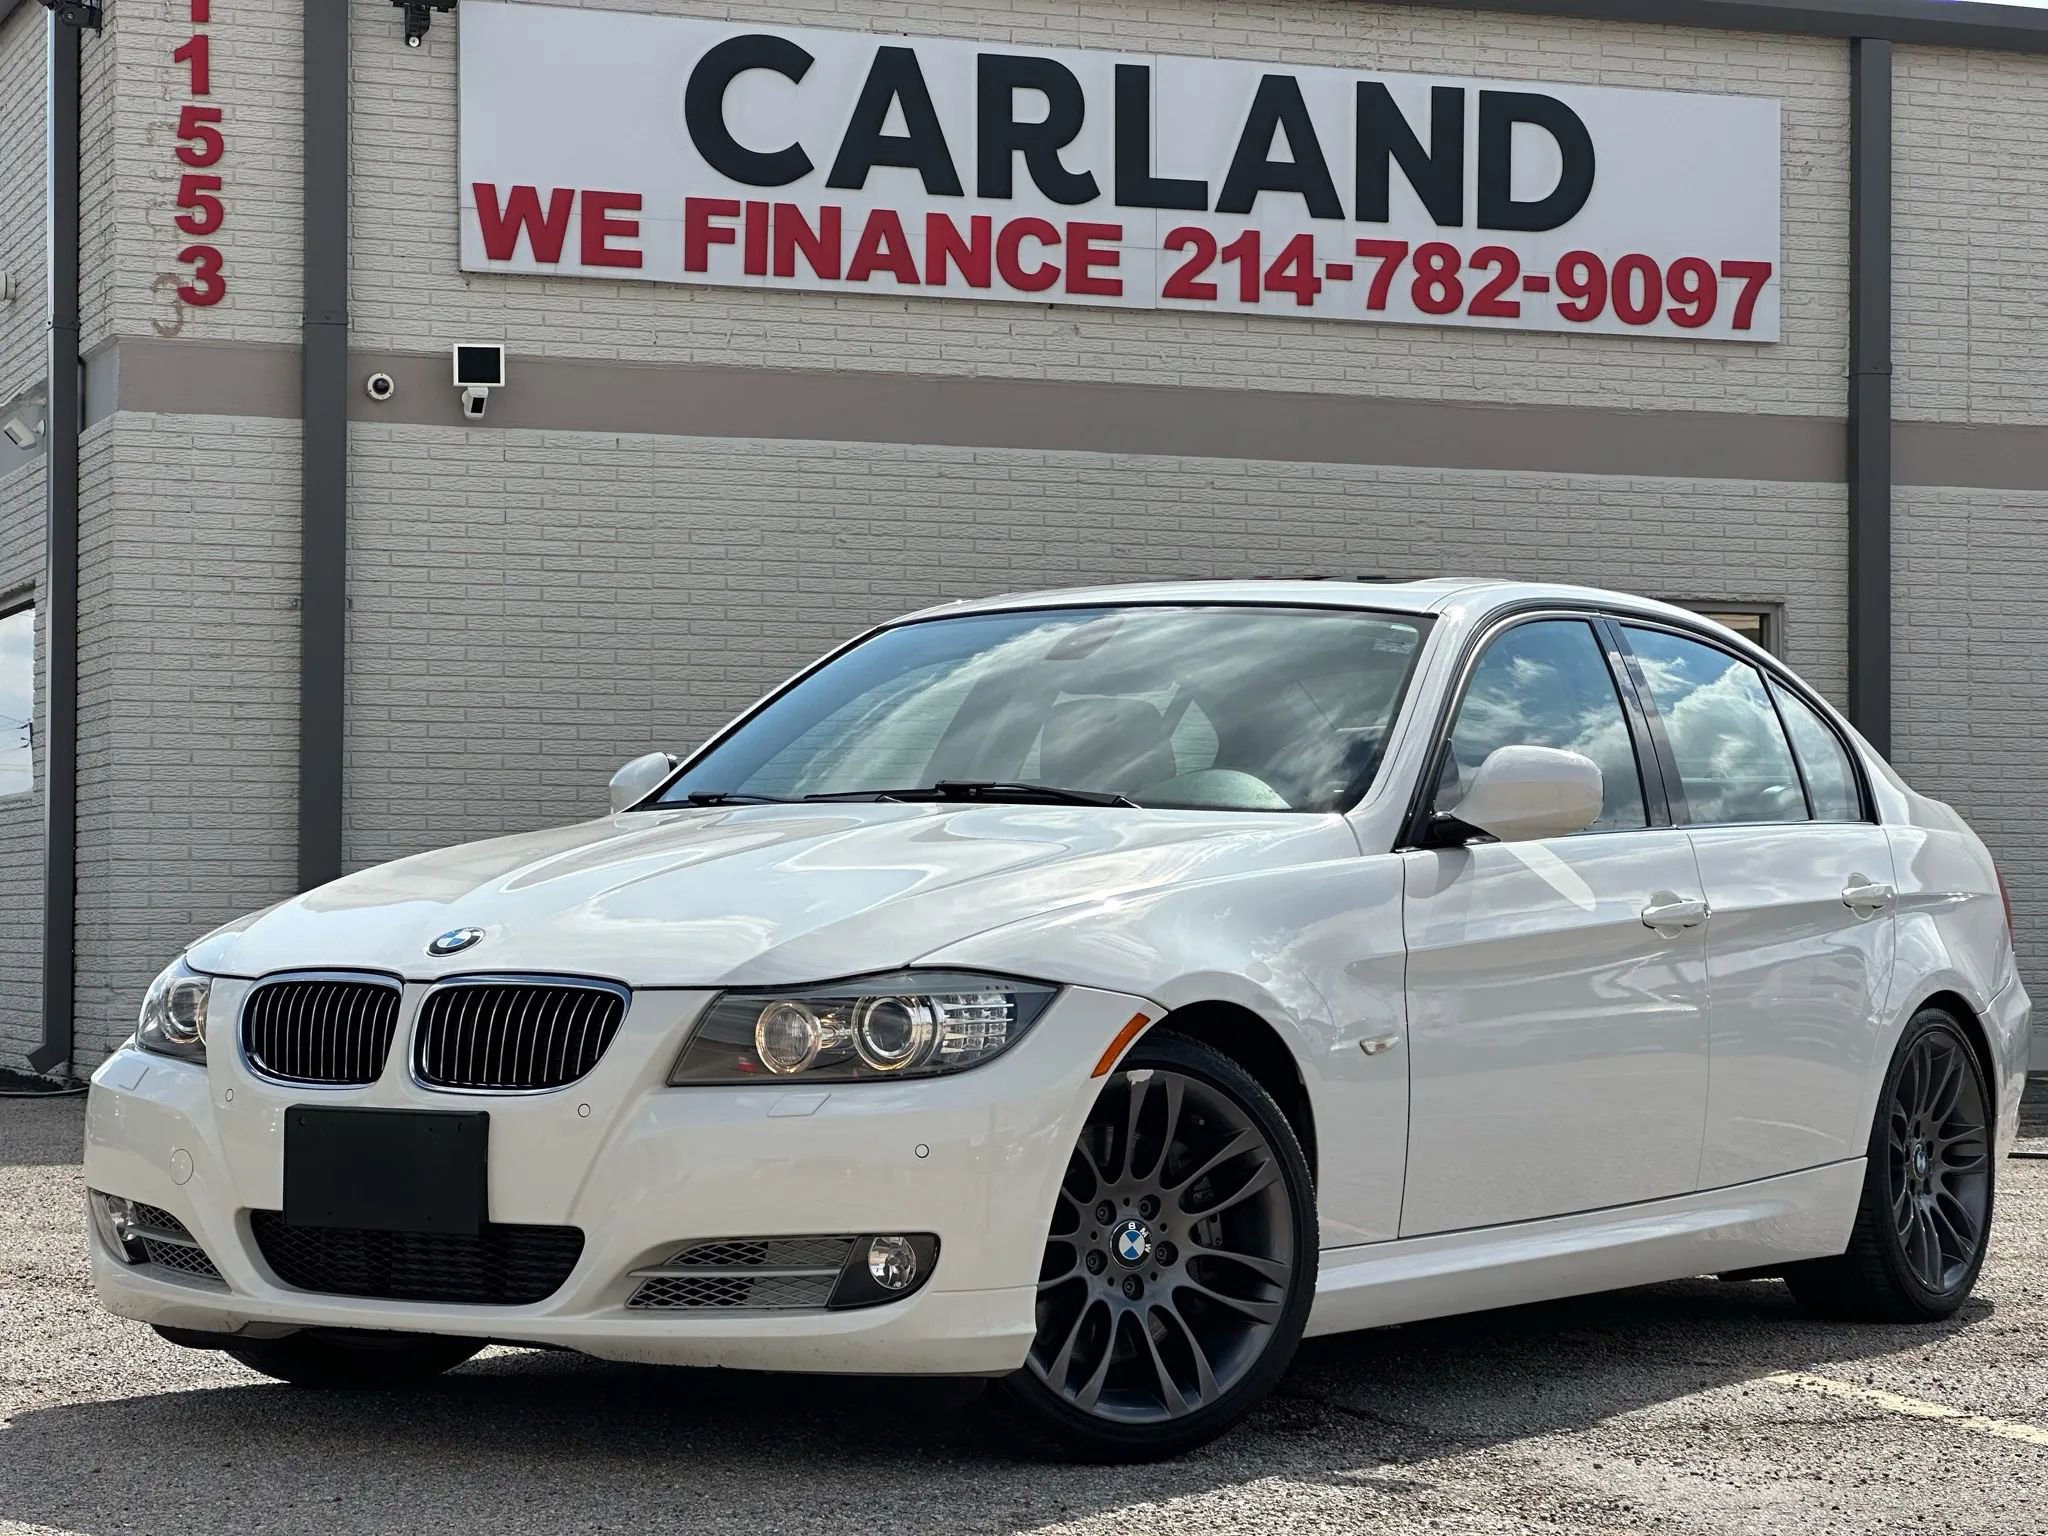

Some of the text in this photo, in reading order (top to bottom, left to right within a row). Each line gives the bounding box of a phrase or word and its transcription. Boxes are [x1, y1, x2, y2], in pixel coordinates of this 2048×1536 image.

[684, 34, 1596, 233] CARLAND
[472, 182, 1772, 330] WE FINANCE 214-782-9097
